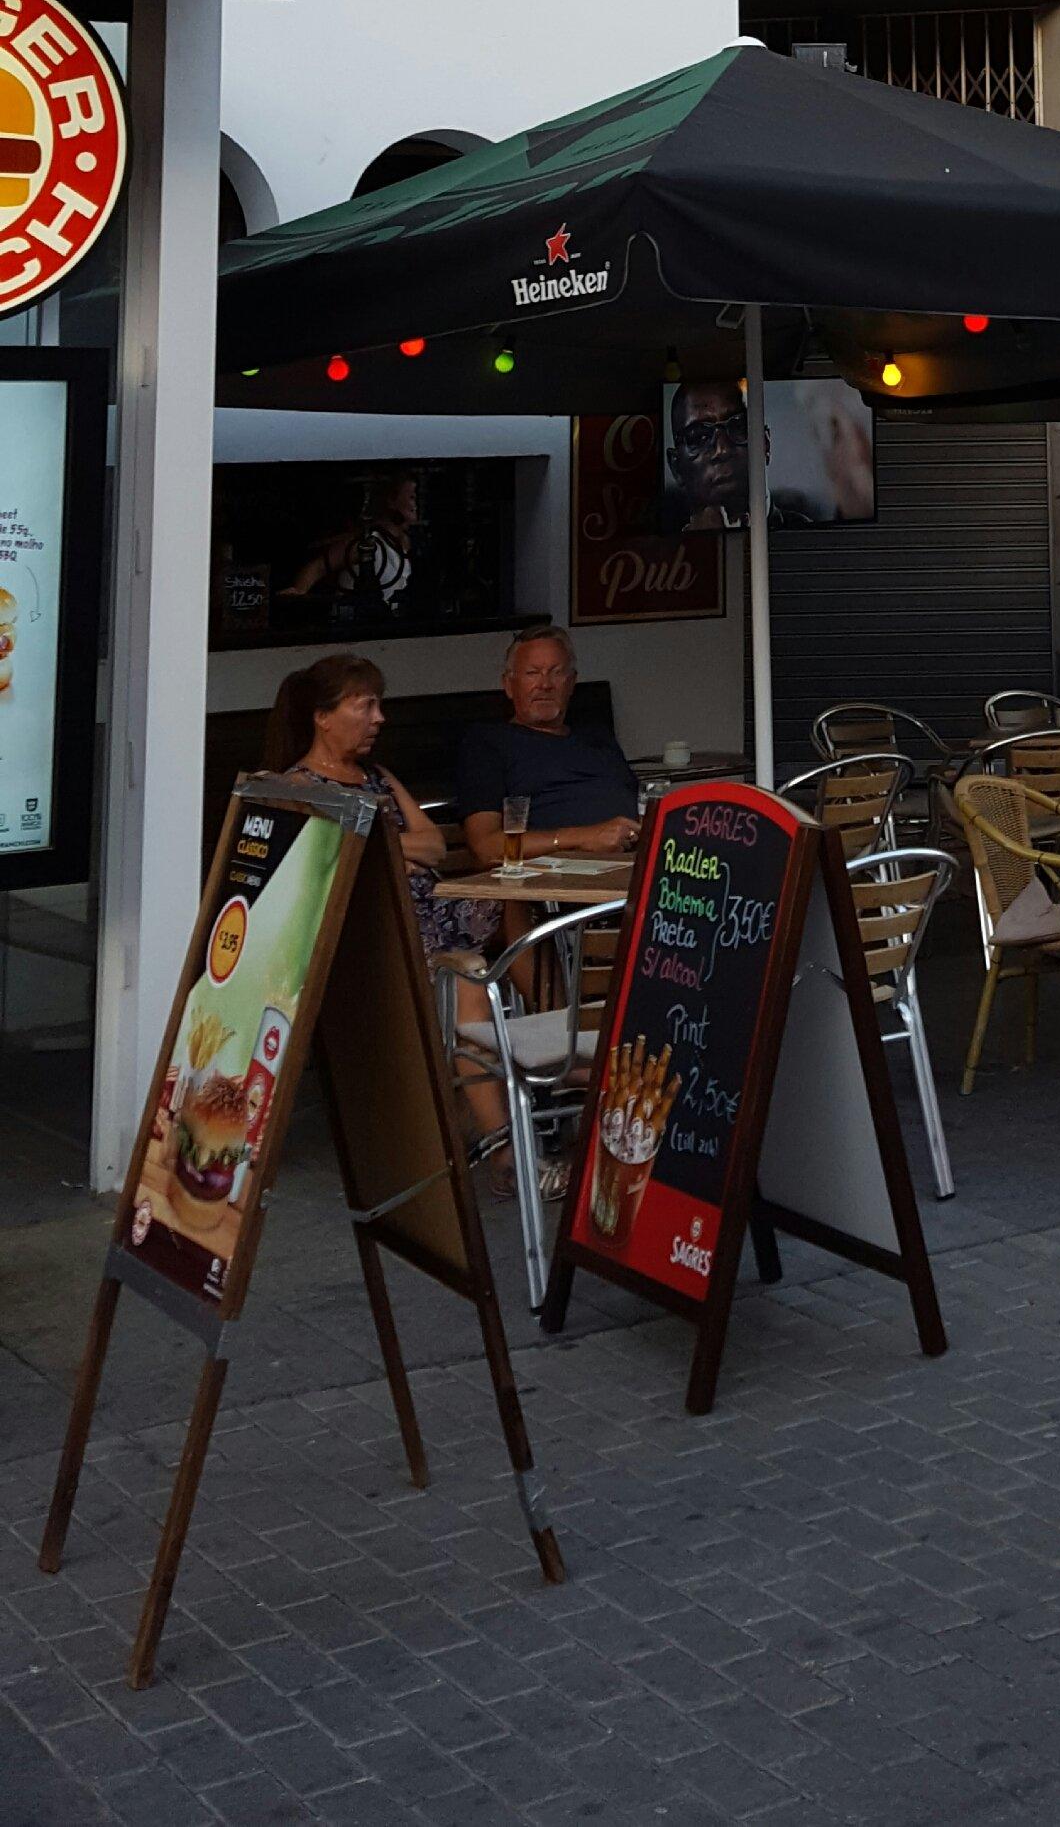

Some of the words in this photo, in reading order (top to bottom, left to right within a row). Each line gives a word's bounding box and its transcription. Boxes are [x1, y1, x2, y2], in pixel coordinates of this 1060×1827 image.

[511, 269, 608, 306] Heineken
[602, 544, 699, 609] Pub
[242, 813, 274, 840] MENU
[685, 806, 759, 846] SAGRES
[658, 877, 719, 922] Bohemia
[651, 910, 697, 948] Preta
[720, 896, 776, 951] 3,50€
[667, 1003, 709, 1051] Pint
[670, 1236, 712, 1278] SAGRES
